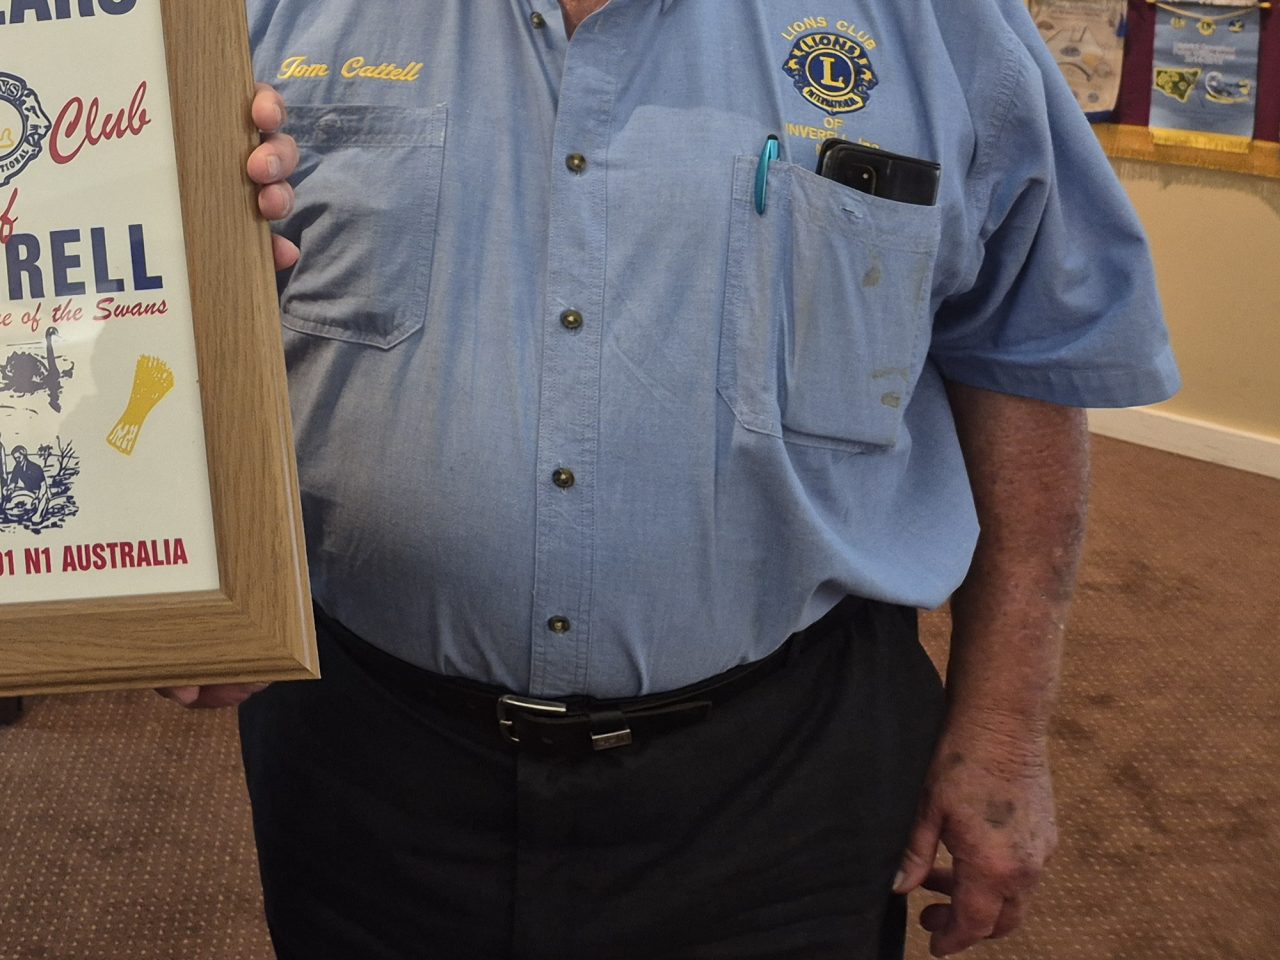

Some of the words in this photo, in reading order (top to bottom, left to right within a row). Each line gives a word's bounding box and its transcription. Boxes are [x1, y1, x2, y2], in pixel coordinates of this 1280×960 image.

[781, 16, 828, 41] LIONS
[836, 20, 877, 51] CLUB
[802, 35, 861, 57] LIONS
[277, 56, 330, 79] Tom
[341, 56, 424, 81] Cattell
[820, 56, 845, 88] L
[48, 80, 152, 165] Club
[823, 117, 845, 129] OF
[20, 303, 43, 333] of
[51, 299, 83, 323] the
[92, 296, 169, 322] Swans
[24, 547, 52, 574] N1
[61, 538, 189, 572] AUSTRALIA
